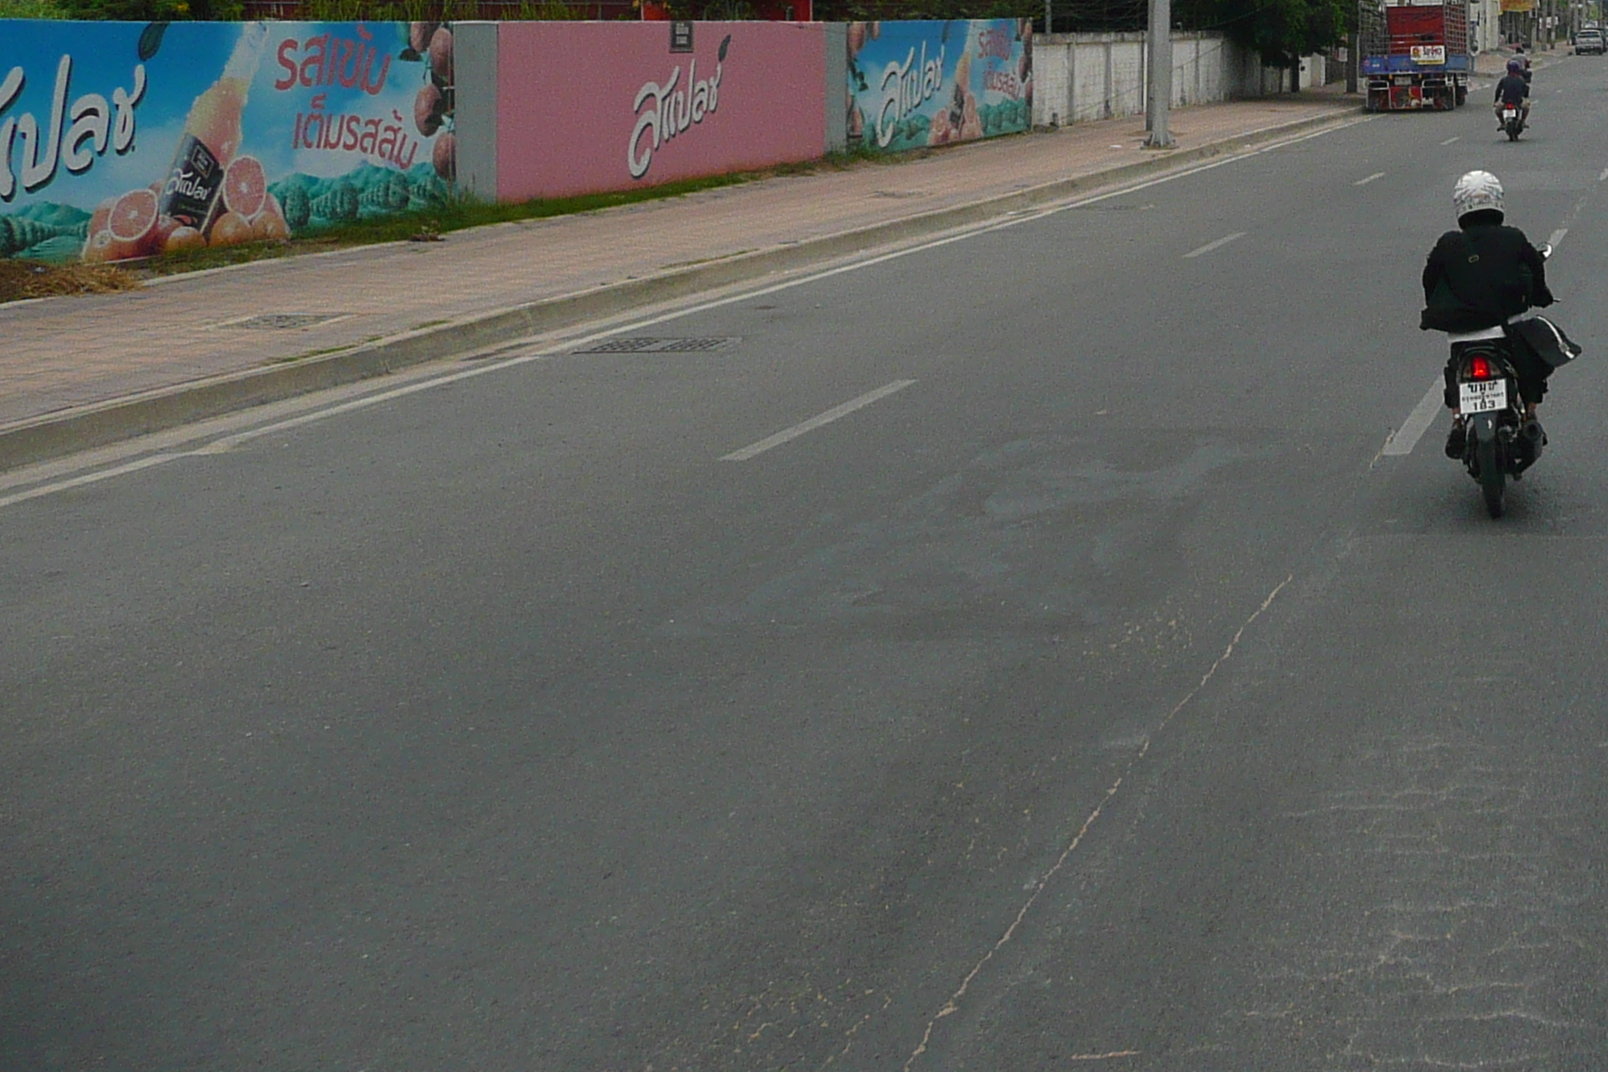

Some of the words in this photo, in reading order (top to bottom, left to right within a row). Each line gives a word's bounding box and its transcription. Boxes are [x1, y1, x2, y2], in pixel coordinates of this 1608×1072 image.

[275, 24, 392, 96] รสเข้ม
[293, 92, 418, 170] เต็มรสส้ม
